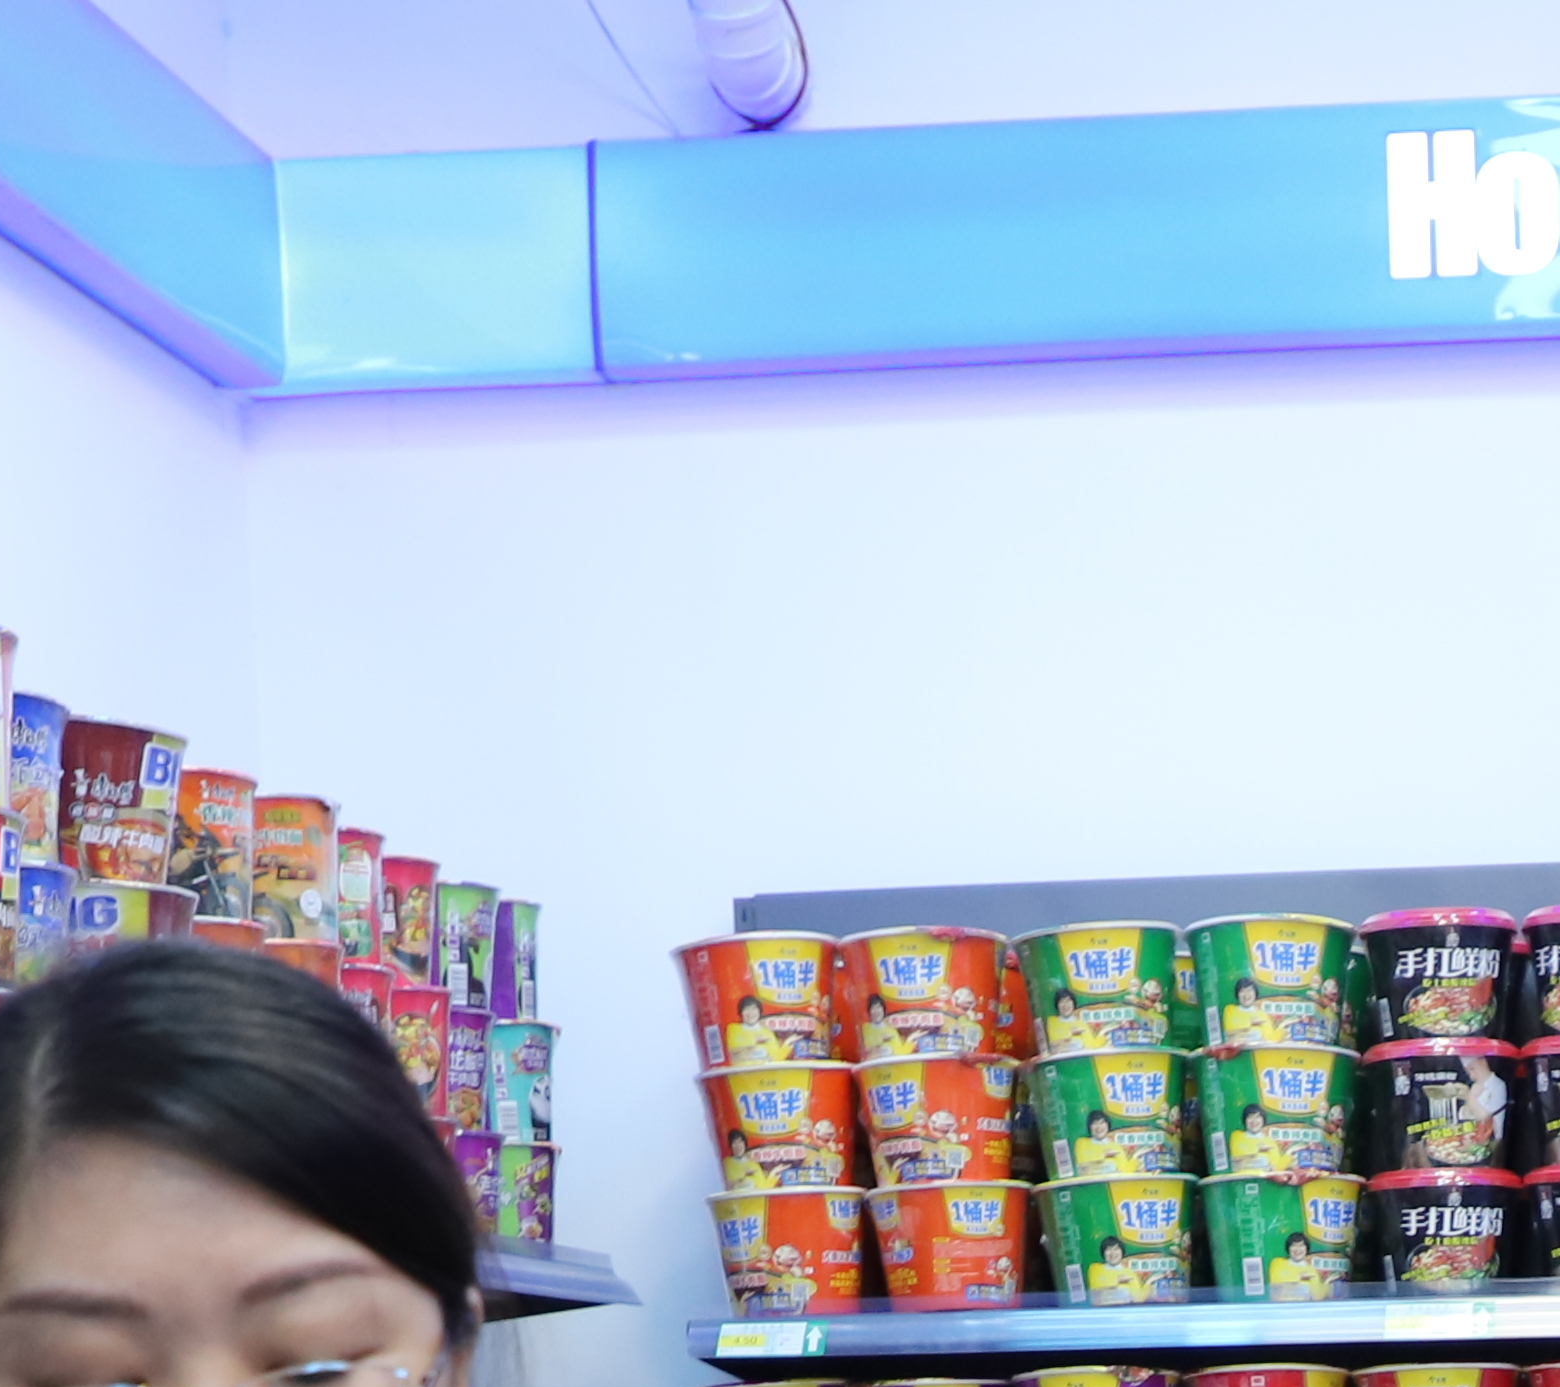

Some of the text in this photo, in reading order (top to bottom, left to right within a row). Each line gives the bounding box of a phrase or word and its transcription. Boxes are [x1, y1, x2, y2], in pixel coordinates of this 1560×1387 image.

[878, 954, 943, 986] 1桶半
[1068, 947, 1134, 980] 1桶半
[1255, 941, 1318, 973] 1桶半
[1394, 946, 1502, 980] 手打鲜粉
[757, 960, 816, 990] 1桶半
[1105, 1072, 1166, 1103] 1桶半
[1263, 1067, 1325, 1100] 1桶半
[739, 1087, 803, 1121] 1桶半
[951, 1199, 1000, 1225] 1桶半
[1120, 1199, 1179, 1231] 1桶半
[1400, 1205, 1504, 1237] 手打鲜粉
